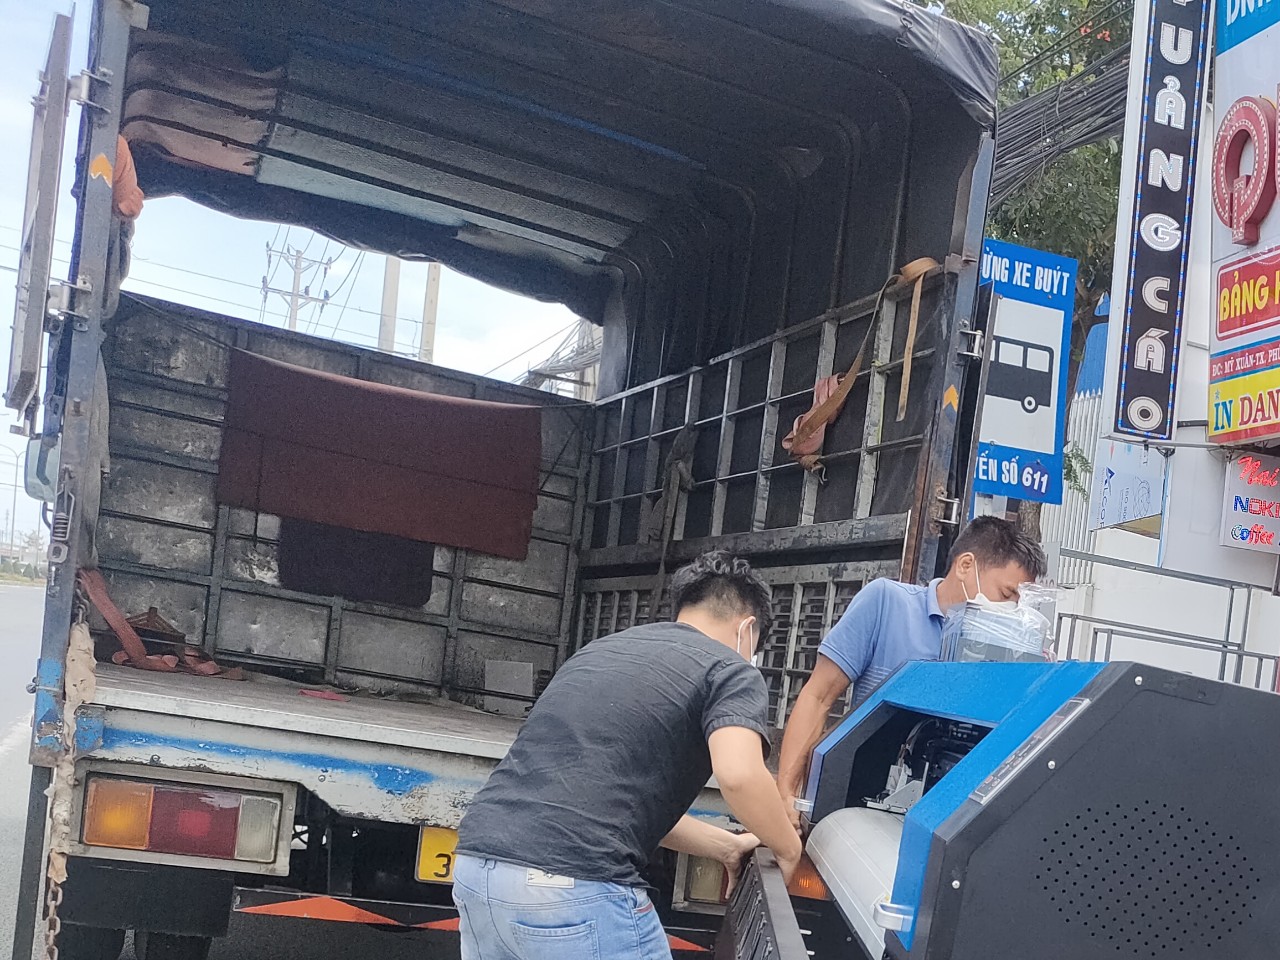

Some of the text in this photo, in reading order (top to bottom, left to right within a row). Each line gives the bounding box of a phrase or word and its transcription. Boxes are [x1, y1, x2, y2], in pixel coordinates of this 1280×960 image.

[1140, 0, 1198, 251] UẢNG
[981, 247, 1070, 296] ỪNG XE BUÝT
[1219, 270, 1269, 322] BẢNG
[1213, 399, 1234, 432] IN
[1001, 455, 1020, 485] SỐ
[1022, 467, 1049, 494] 611
[1230, 523, 1274, 545] Coffee
